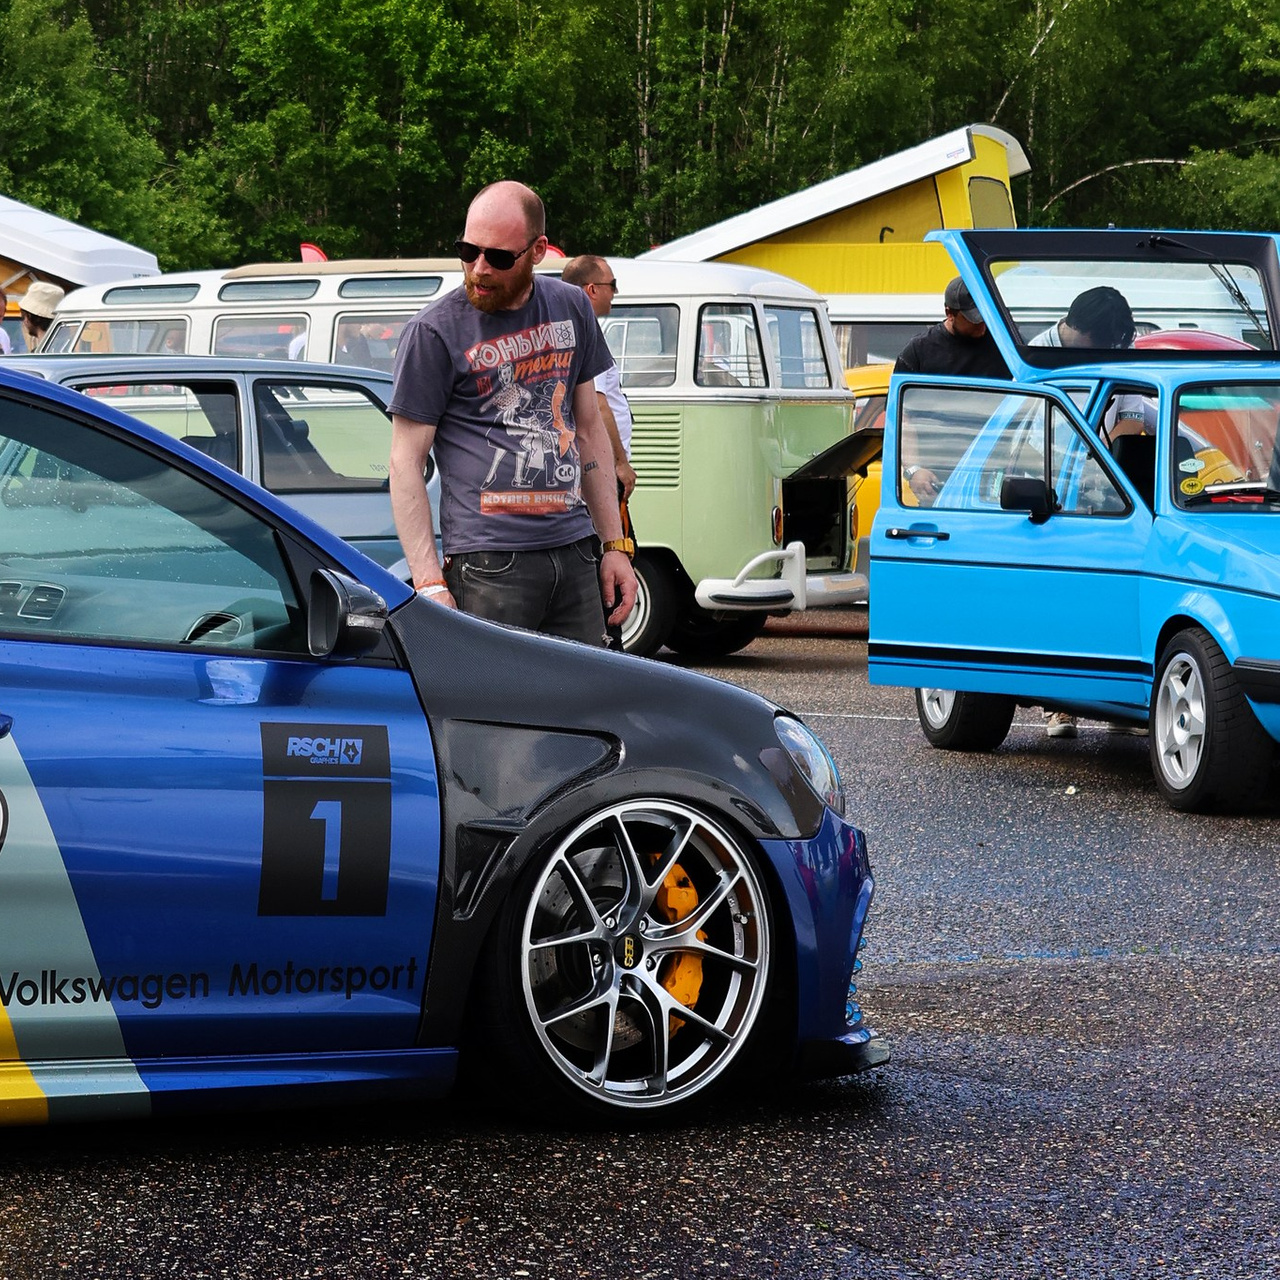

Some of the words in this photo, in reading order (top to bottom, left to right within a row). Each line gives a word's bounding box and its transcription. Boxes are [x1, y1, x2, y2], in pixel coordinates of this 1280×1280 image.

[286, 737, 340, 757] RSCH
[309, 800, 342, 901] 1
[624, 936, 634, 968] BBS
[228, 956, 418, 999] Motorsport
